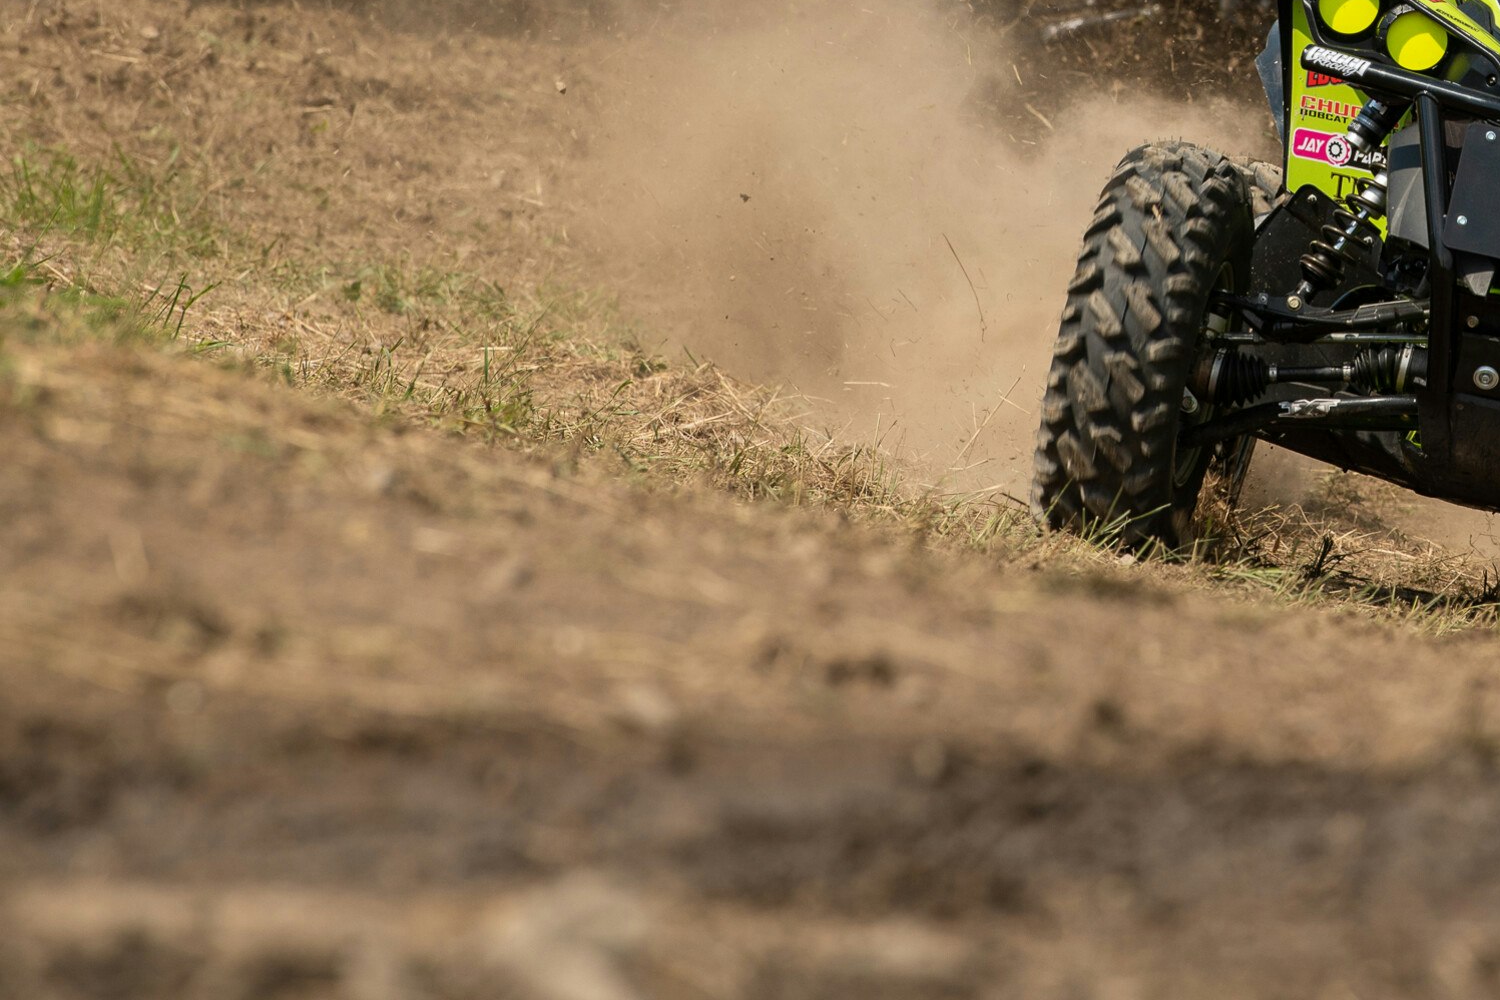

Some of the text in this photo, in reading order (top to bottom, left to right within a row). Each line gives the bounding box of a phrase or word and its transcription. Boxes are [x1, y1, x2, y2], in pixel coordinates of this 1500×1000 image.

[1300, 95, 1363, 119] CHUC
[1300, 107, 1349, 124] BOBCAT
[1297, 136, 1325, 154] JAY
